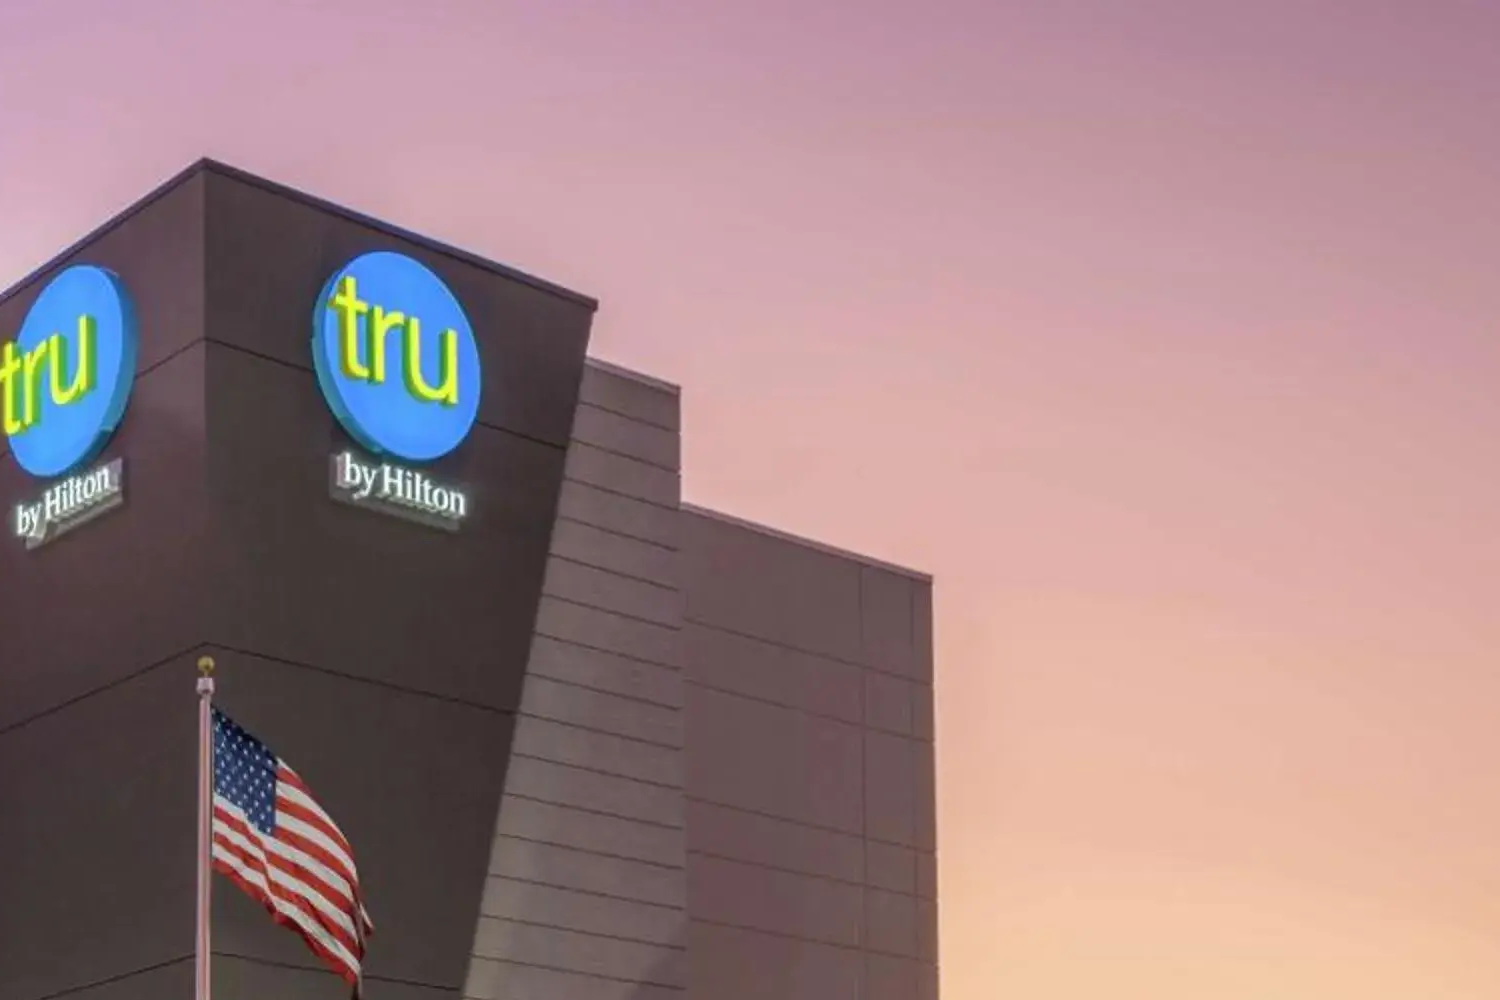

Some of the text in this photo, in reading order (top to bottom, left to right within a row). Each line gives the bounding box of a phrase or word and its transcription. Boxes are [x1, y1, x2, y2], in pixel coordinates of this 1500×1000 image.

[327, 275, 458, 406] tru
[16, 466, 110, 537] by Hilton
[343, 451, 466, 516] by Hilton
